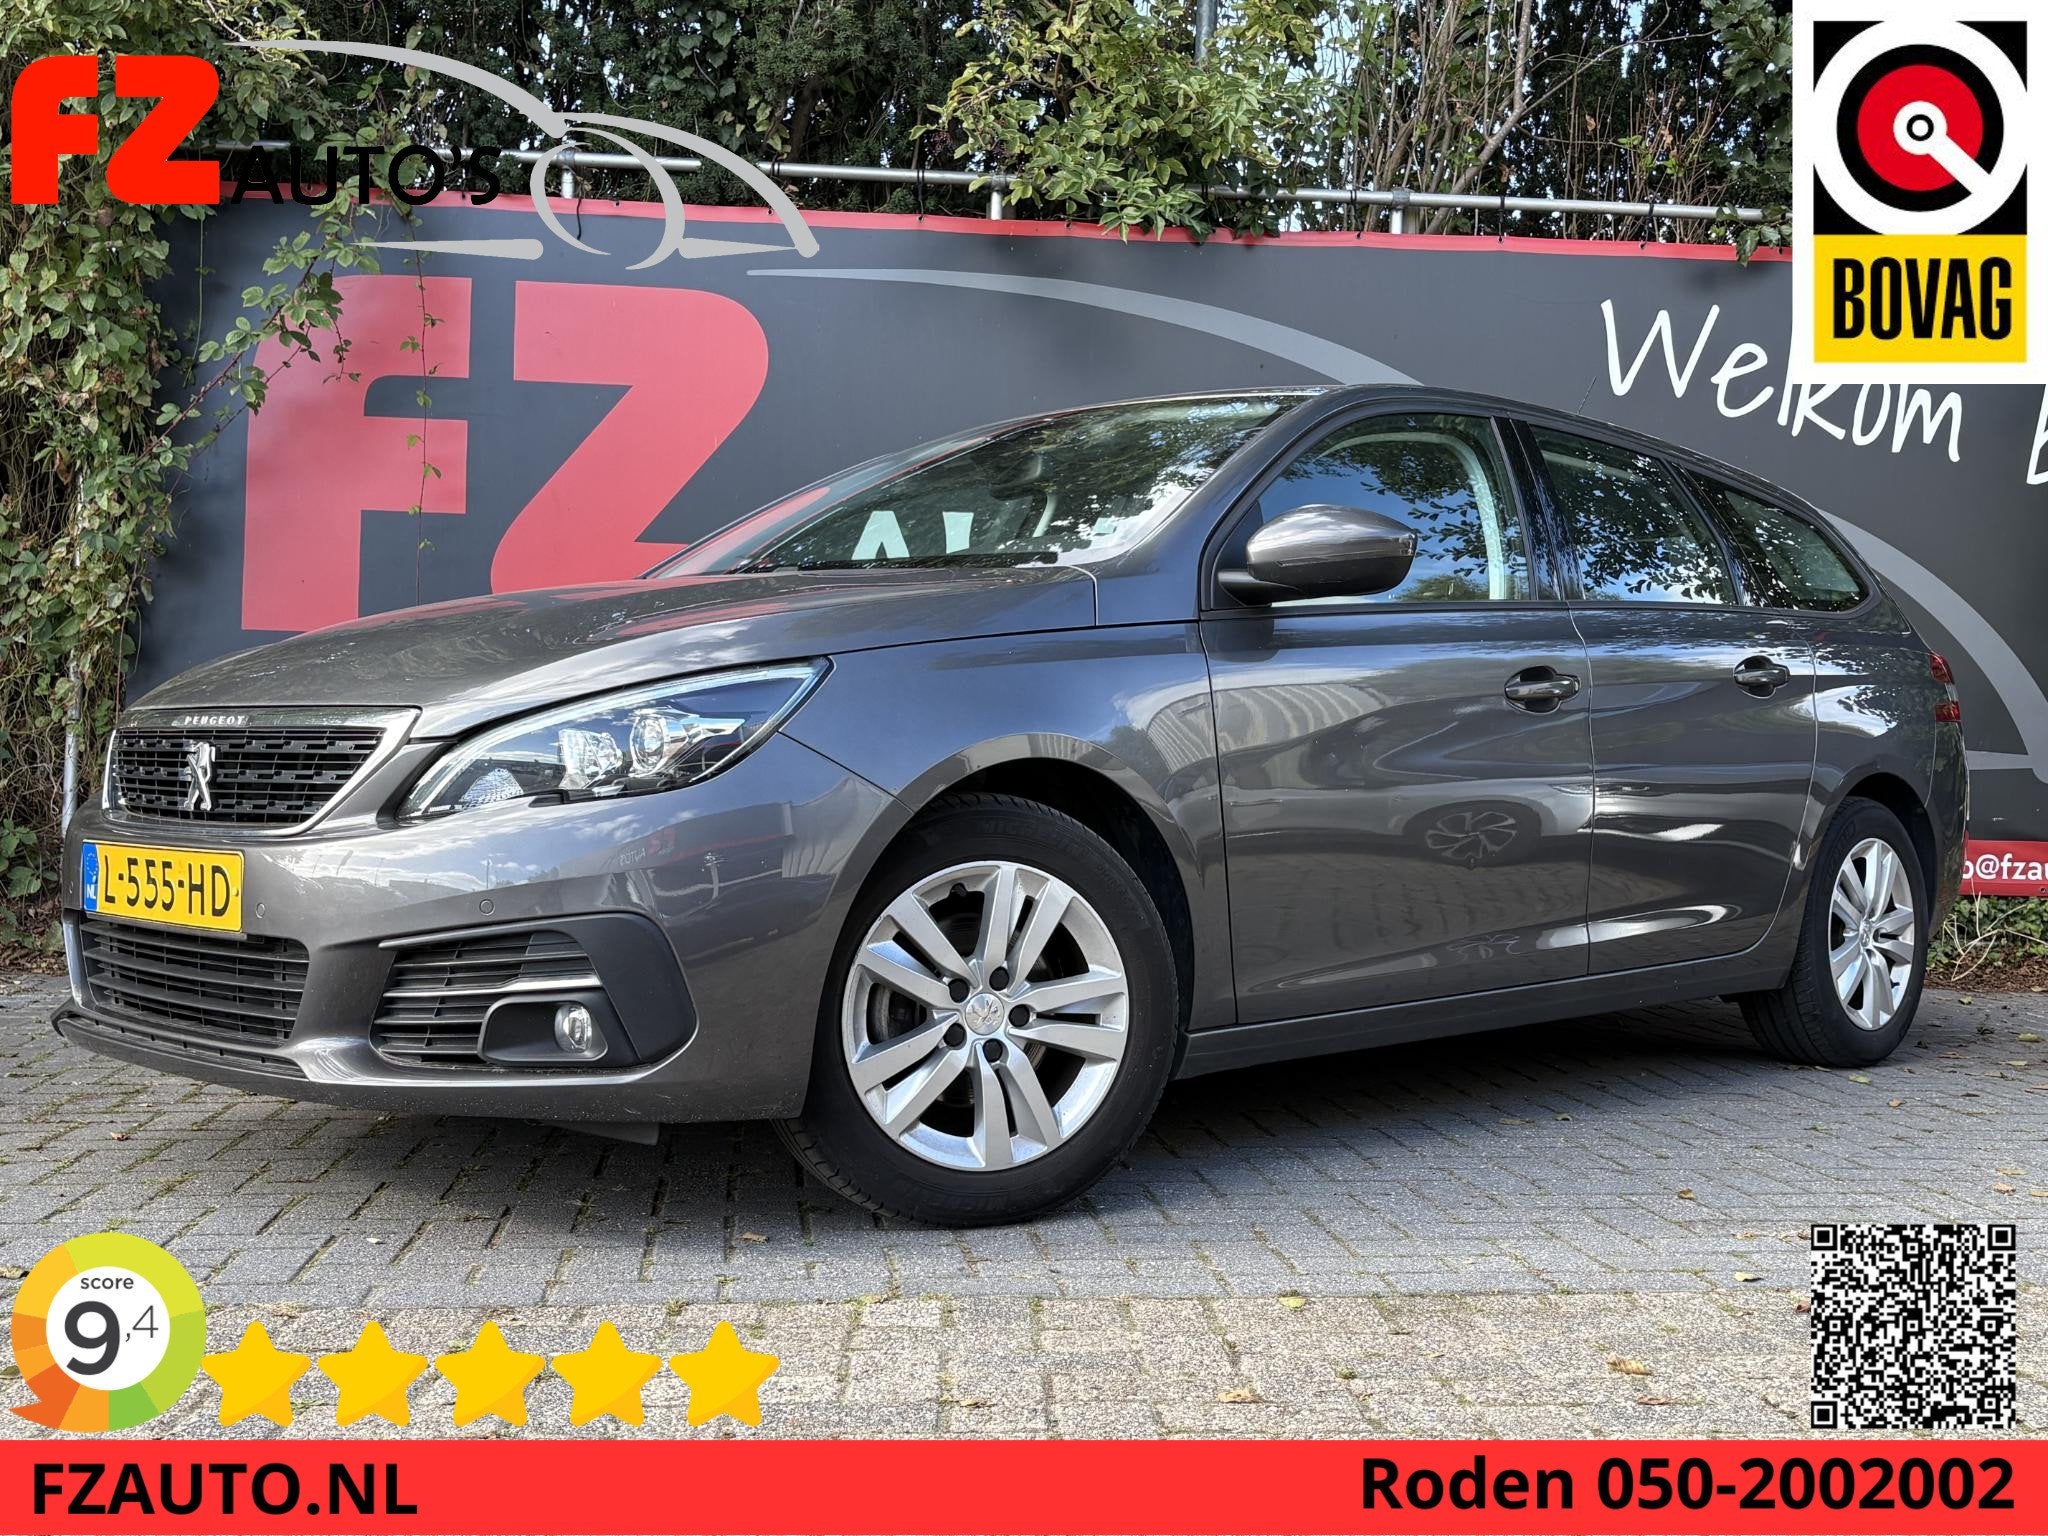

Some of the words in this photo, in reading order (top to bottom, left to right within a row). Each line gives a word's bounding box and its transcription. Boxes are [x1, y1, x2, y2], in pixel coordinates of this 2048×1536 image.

[242, 275, 769, 631] FZ
[184, 715, 245, 726] PEUGEOT
[86, 885, 97, 900] NL
[103, 854, 231, 918] L-555-HD
